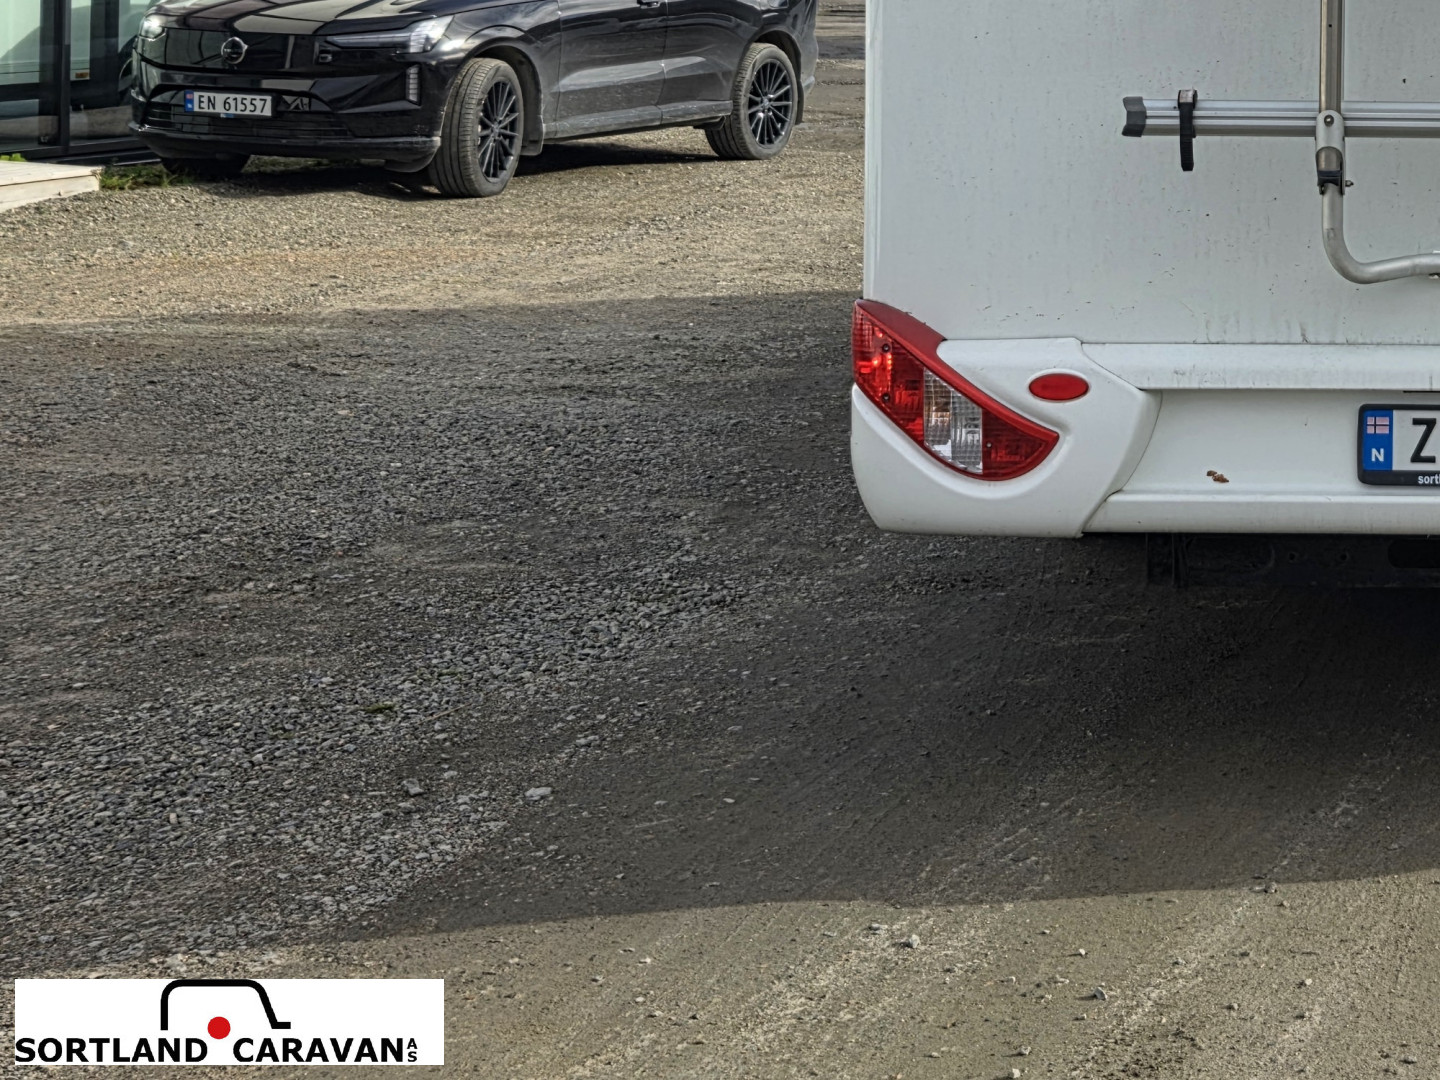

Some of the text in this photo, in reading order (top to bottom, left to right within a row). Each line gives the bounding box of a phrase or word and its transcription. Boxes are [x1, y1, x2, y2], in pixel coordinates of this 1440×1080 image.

[198, 94, 268, 114] EN 61557
[1371, 448, 1385, 462] N
